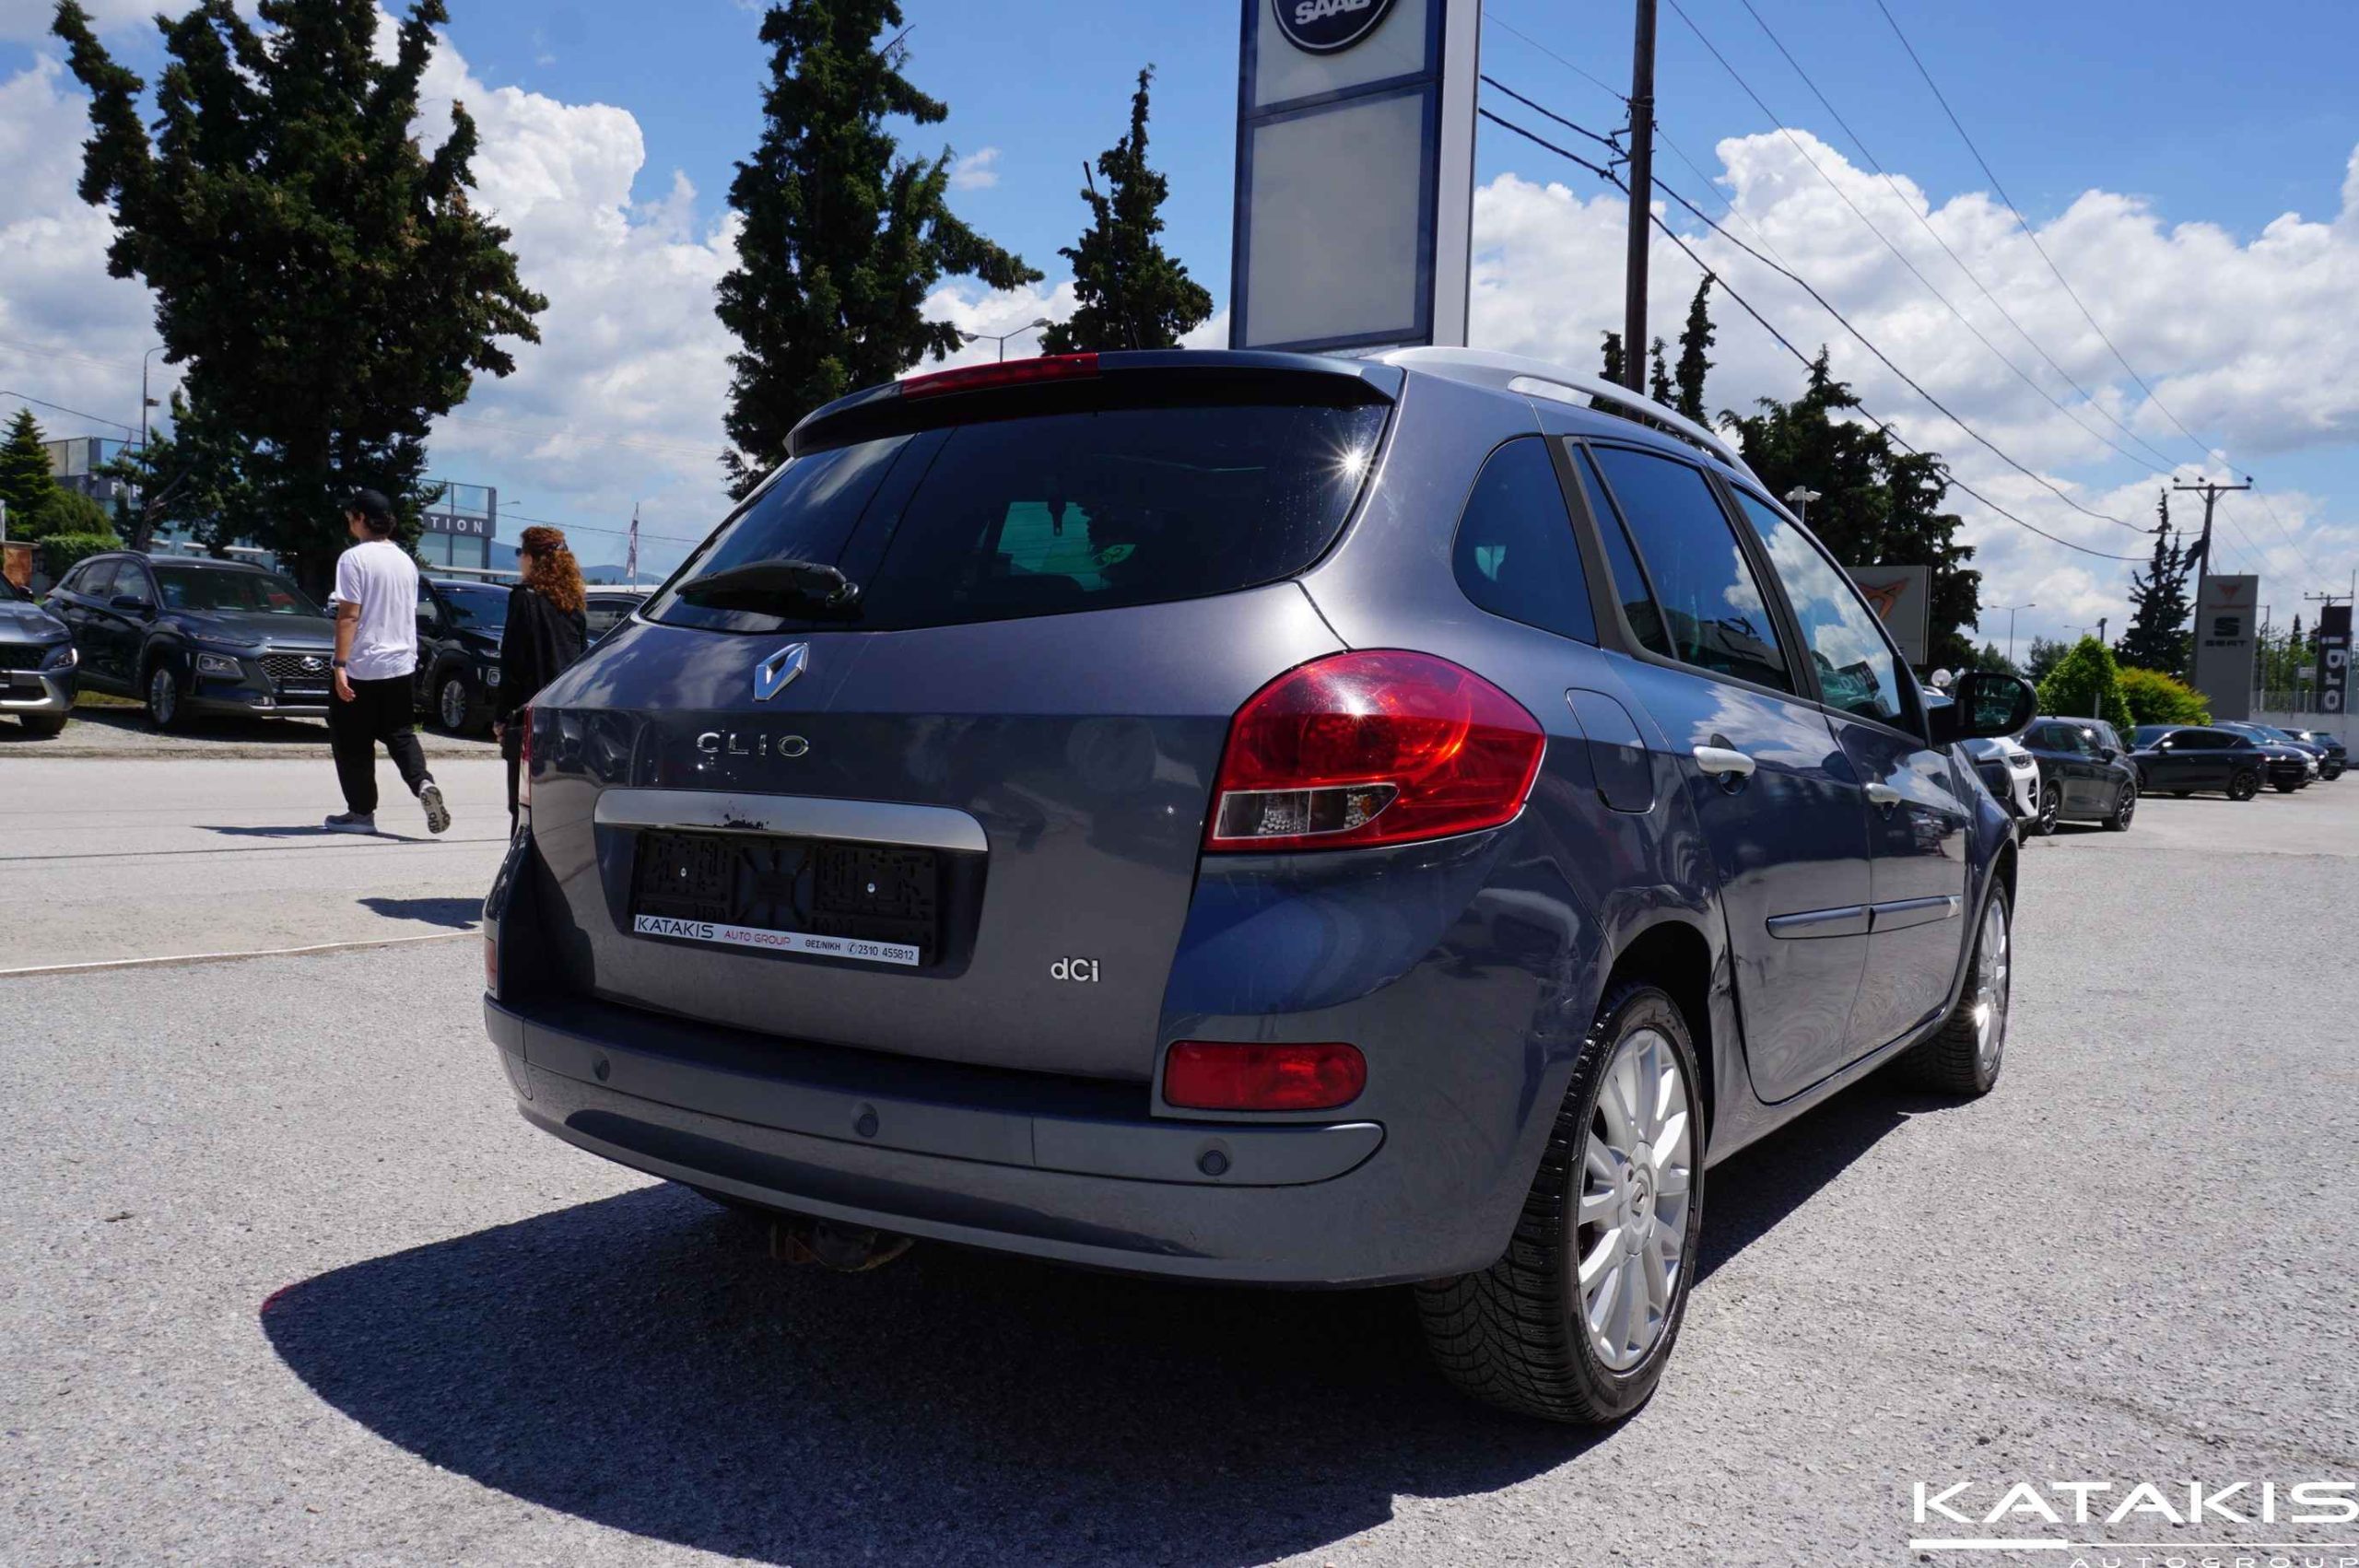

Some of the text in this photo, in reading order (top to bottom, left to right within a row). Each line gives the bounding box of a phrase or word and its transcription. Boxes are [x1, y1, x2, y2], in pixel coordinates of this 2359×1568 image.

[697, 731, 809, 756] CLIO
[638, 917, 715, 939] KATAKIS
[723, 930, 752, 942] AUTO
[754, 933, 792, 946] GROUP
[858, 944, 878, 956] 2310
[882, 947, 914, 961] 455812
[1050, 957, 1099, 982] dCi
